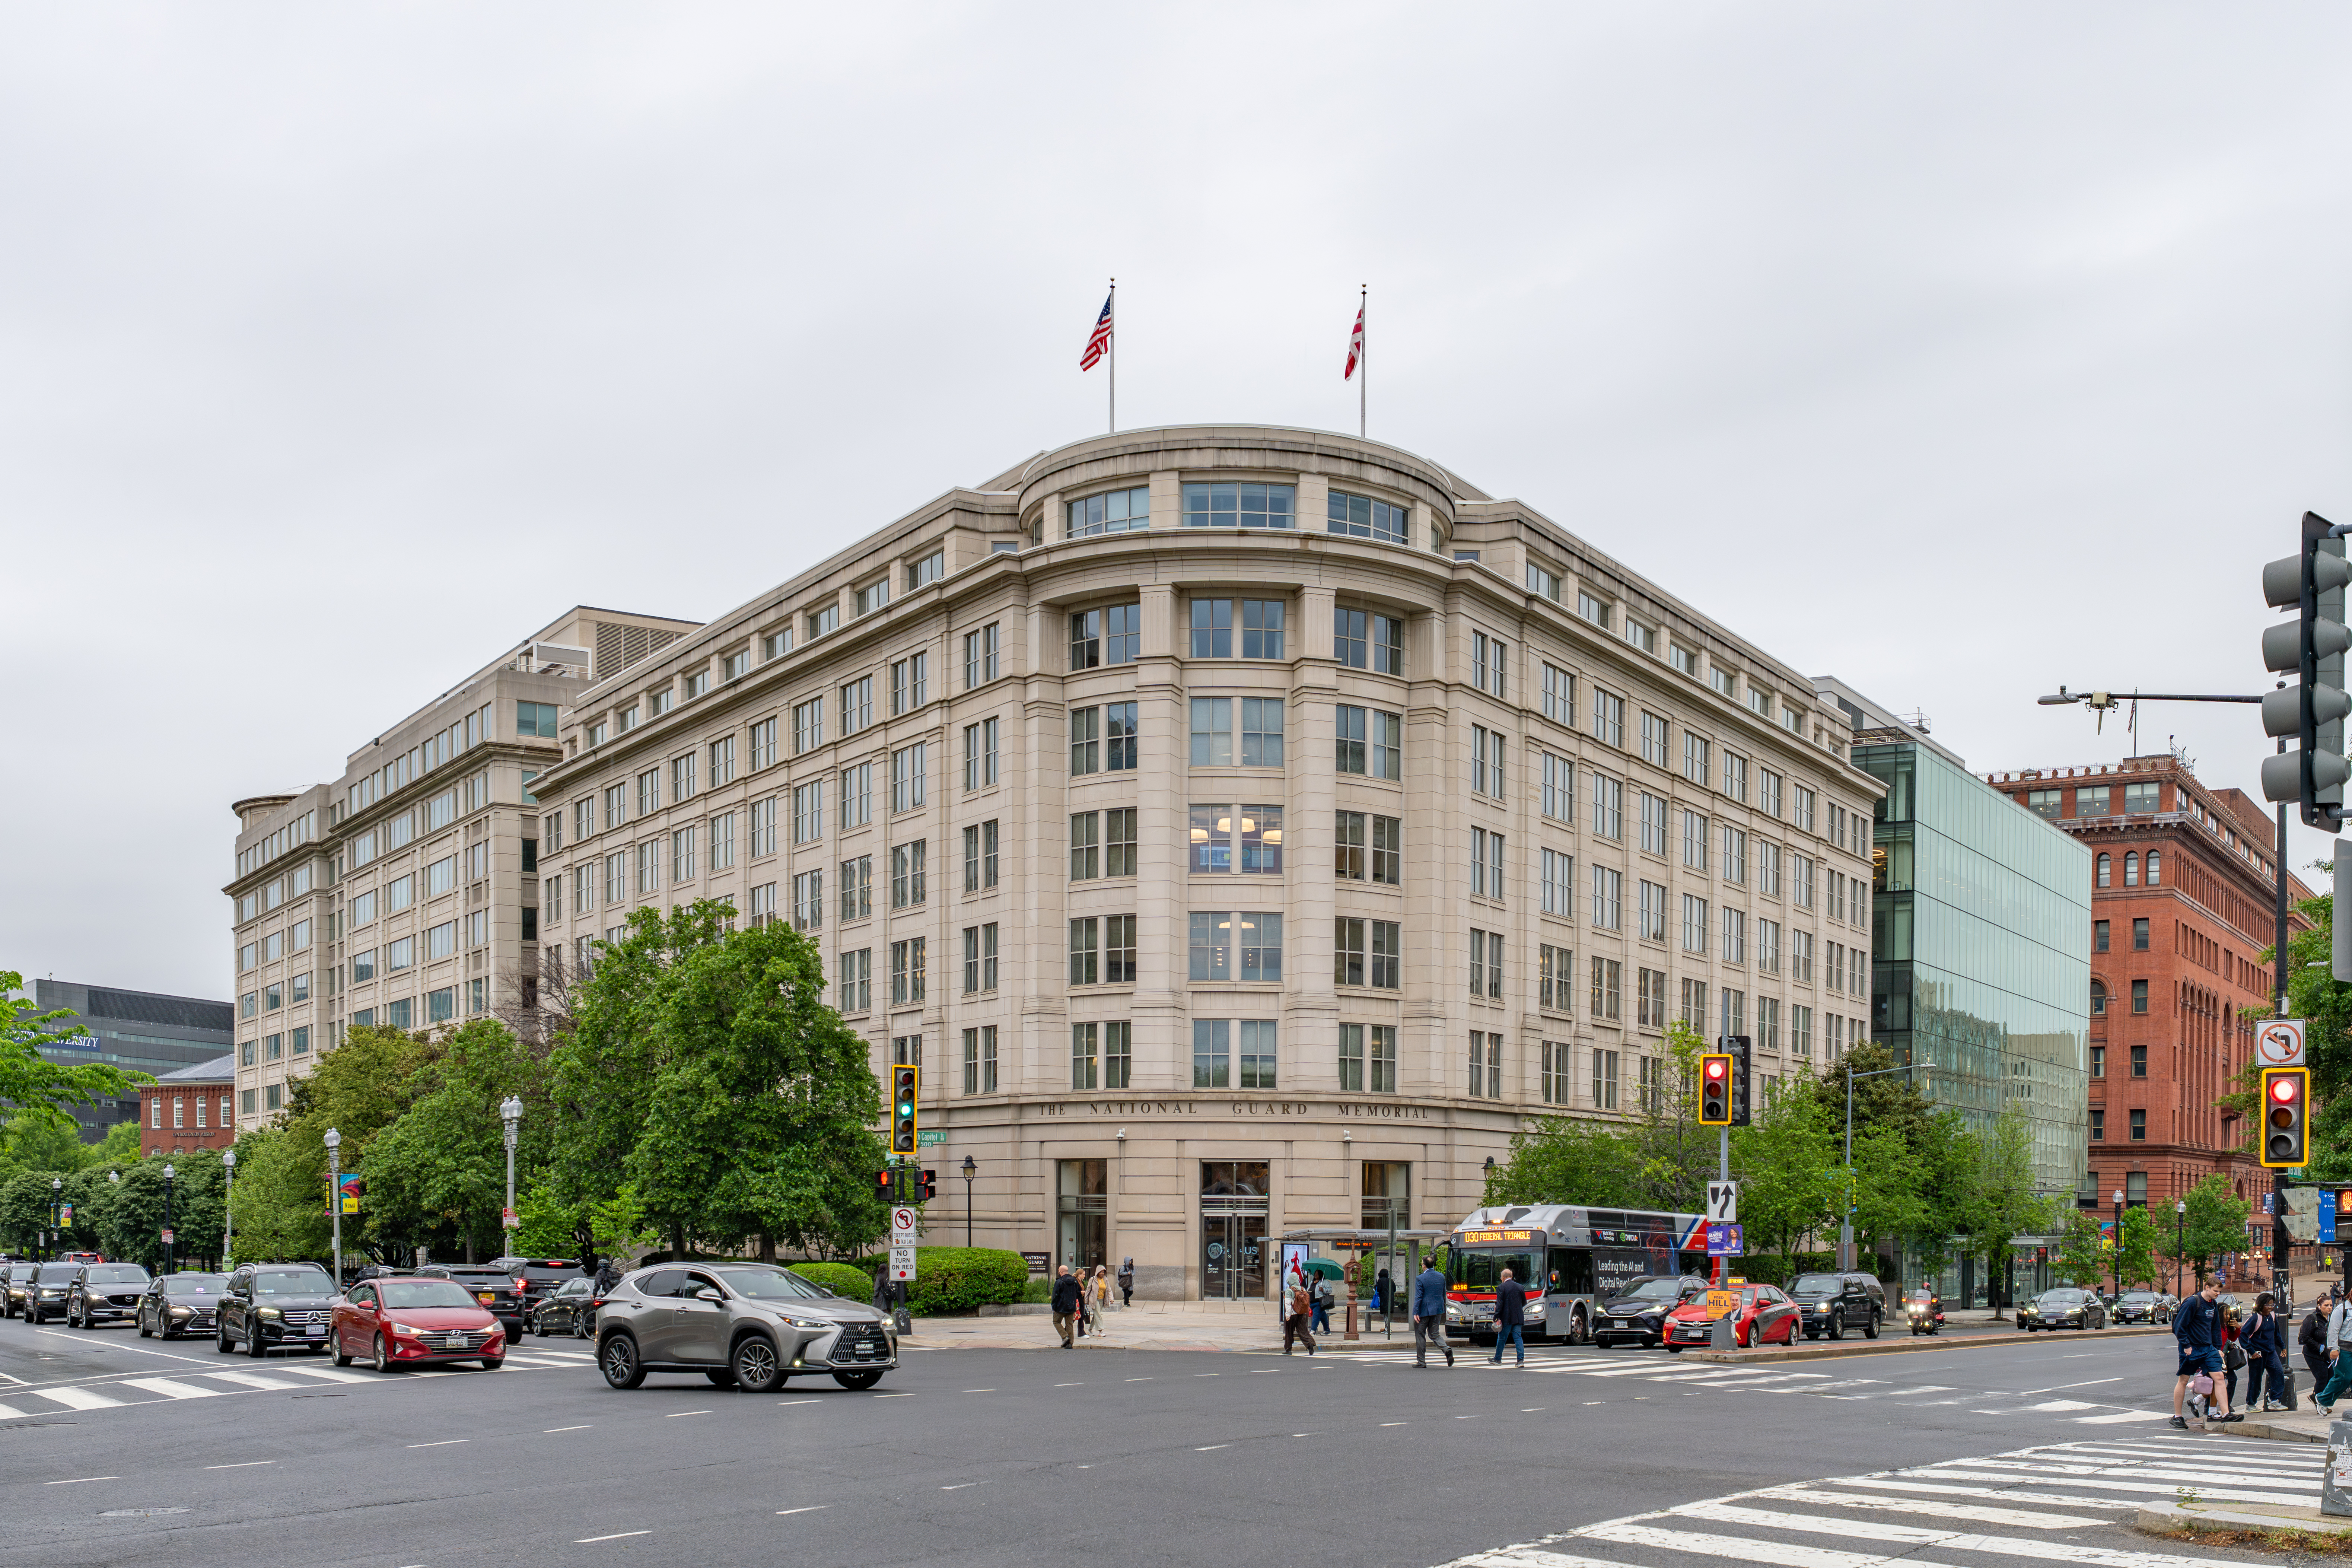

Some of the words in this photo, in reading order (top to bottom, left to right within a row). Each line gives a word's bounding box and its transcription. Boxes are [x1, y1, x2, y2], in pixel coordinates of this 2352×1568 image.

[1040, 1104, 1065, 1115] THE
[1090, 1103, 1197, 1114] NATIONAL
[1232, 1103, 1307, 1114] GUARD
[1338, 1105, 1428, 1119] MEMORIAL
[922, 1133, 937, 1141] Capitol
[1465, 1232, 1479, 1243] D30
[1479, 1232, 1503, 1241] FEDERAL
[1503, 1231, 1530, 1240] TRIANGLE
[1598, 1260, 1619, 1274] Leading
[1619, 1260, 1628, 1272] the
[1629, 1261, 1634, 1272] AI
[1635, 1261, 1644, 1272] and
[1599, 1277, 1616, 1291] Digital
